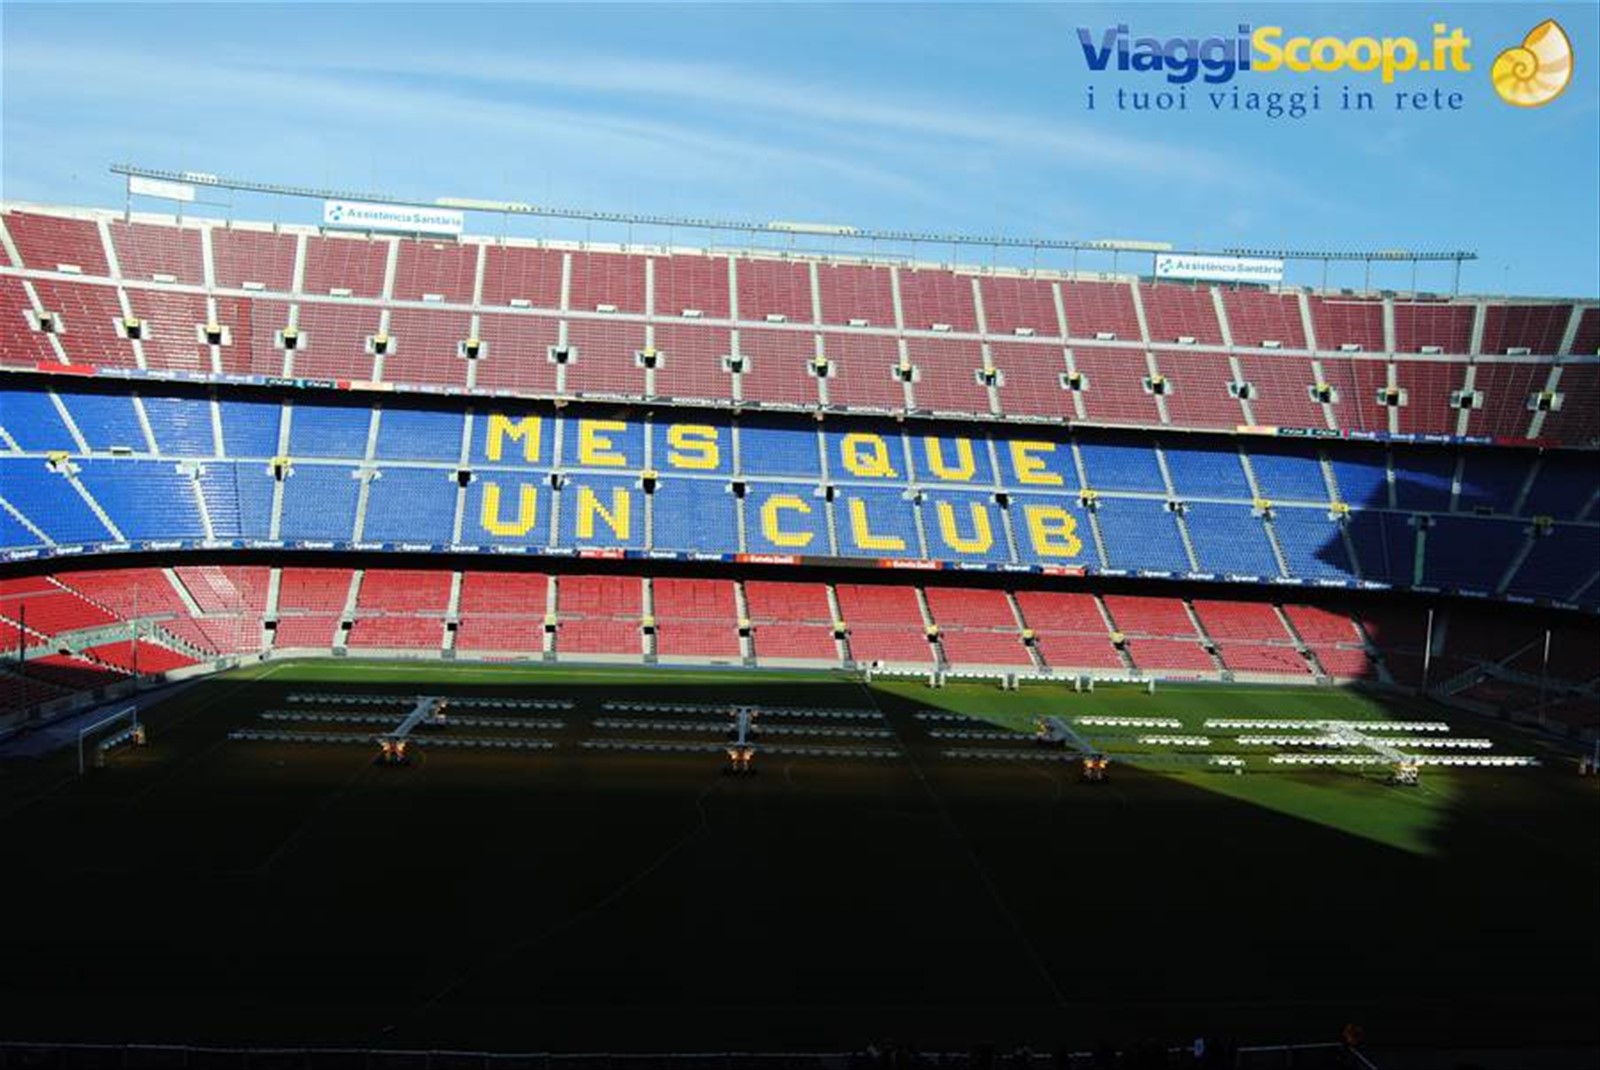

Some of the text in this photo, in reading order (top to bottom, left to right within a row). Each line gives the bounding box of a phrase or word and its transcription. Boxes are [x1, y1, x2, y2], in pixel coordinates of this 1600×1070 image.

[486, 414, 1064, 485] MES QUE
[481, 482, 1083, 558] UN CLUB
